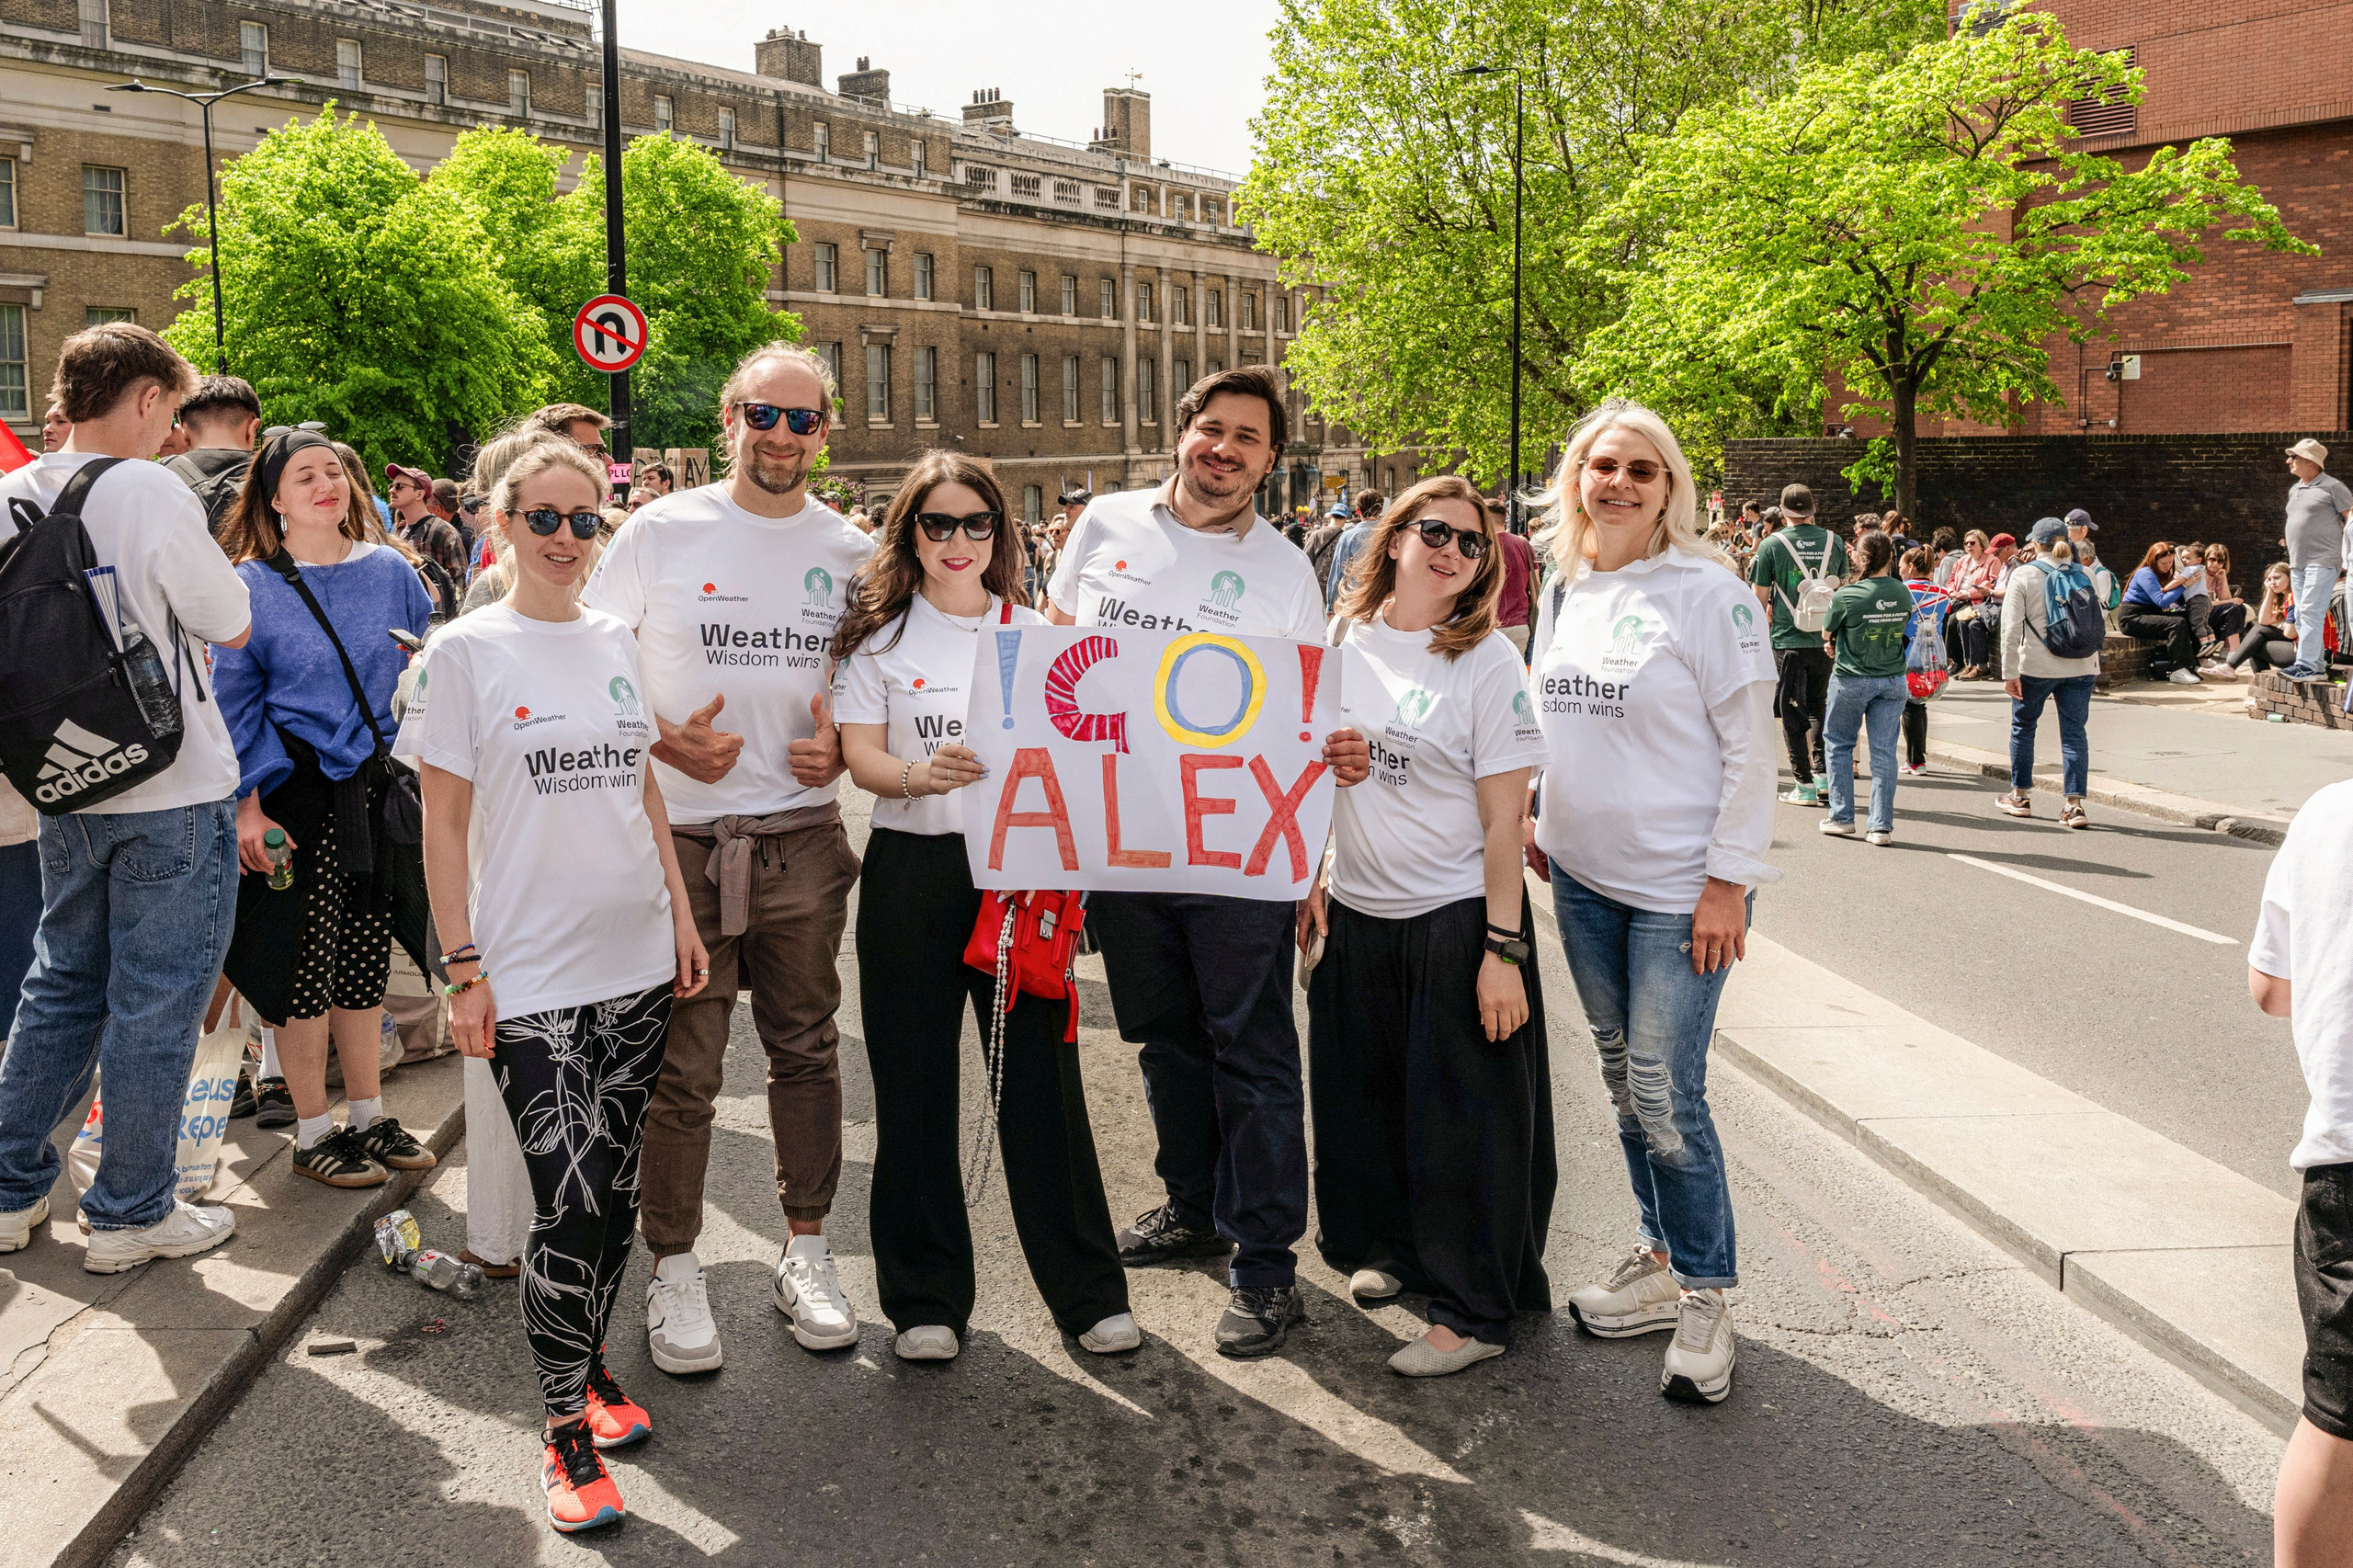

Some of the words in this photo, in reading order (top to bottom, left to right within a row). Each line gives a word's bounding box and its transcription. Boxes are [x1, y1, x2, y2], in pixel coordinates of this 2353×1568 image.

[1108, 569, 1152, 586] OpenWeather
[698, 595, 749, 603] OpenWeather
[801, 608, 836, 621] Weather
[1097, 595, 1210, 633] Weath
[1197, 613, 1236, 629] Foundation
[1199, 603, 1240, 623] Weather
[706, 649, 779, 667] Wisdom
[786, 653, 821, 669] wins
[1602, 656, 1639, 667] Weather
[1587, 700, 1625, 718] wins
[513, 714, 567, 731] OpenWeather
[1384, 734, 1416, 750] Foundation
[1385, 725, 1419, 744] Weather
[35, 743, 149, 803] adidas
[1378, 768, 1408, 787] wins
[534, 773, 608, 796] Wisdom
[987, 747, 1328, 884] ALEX
